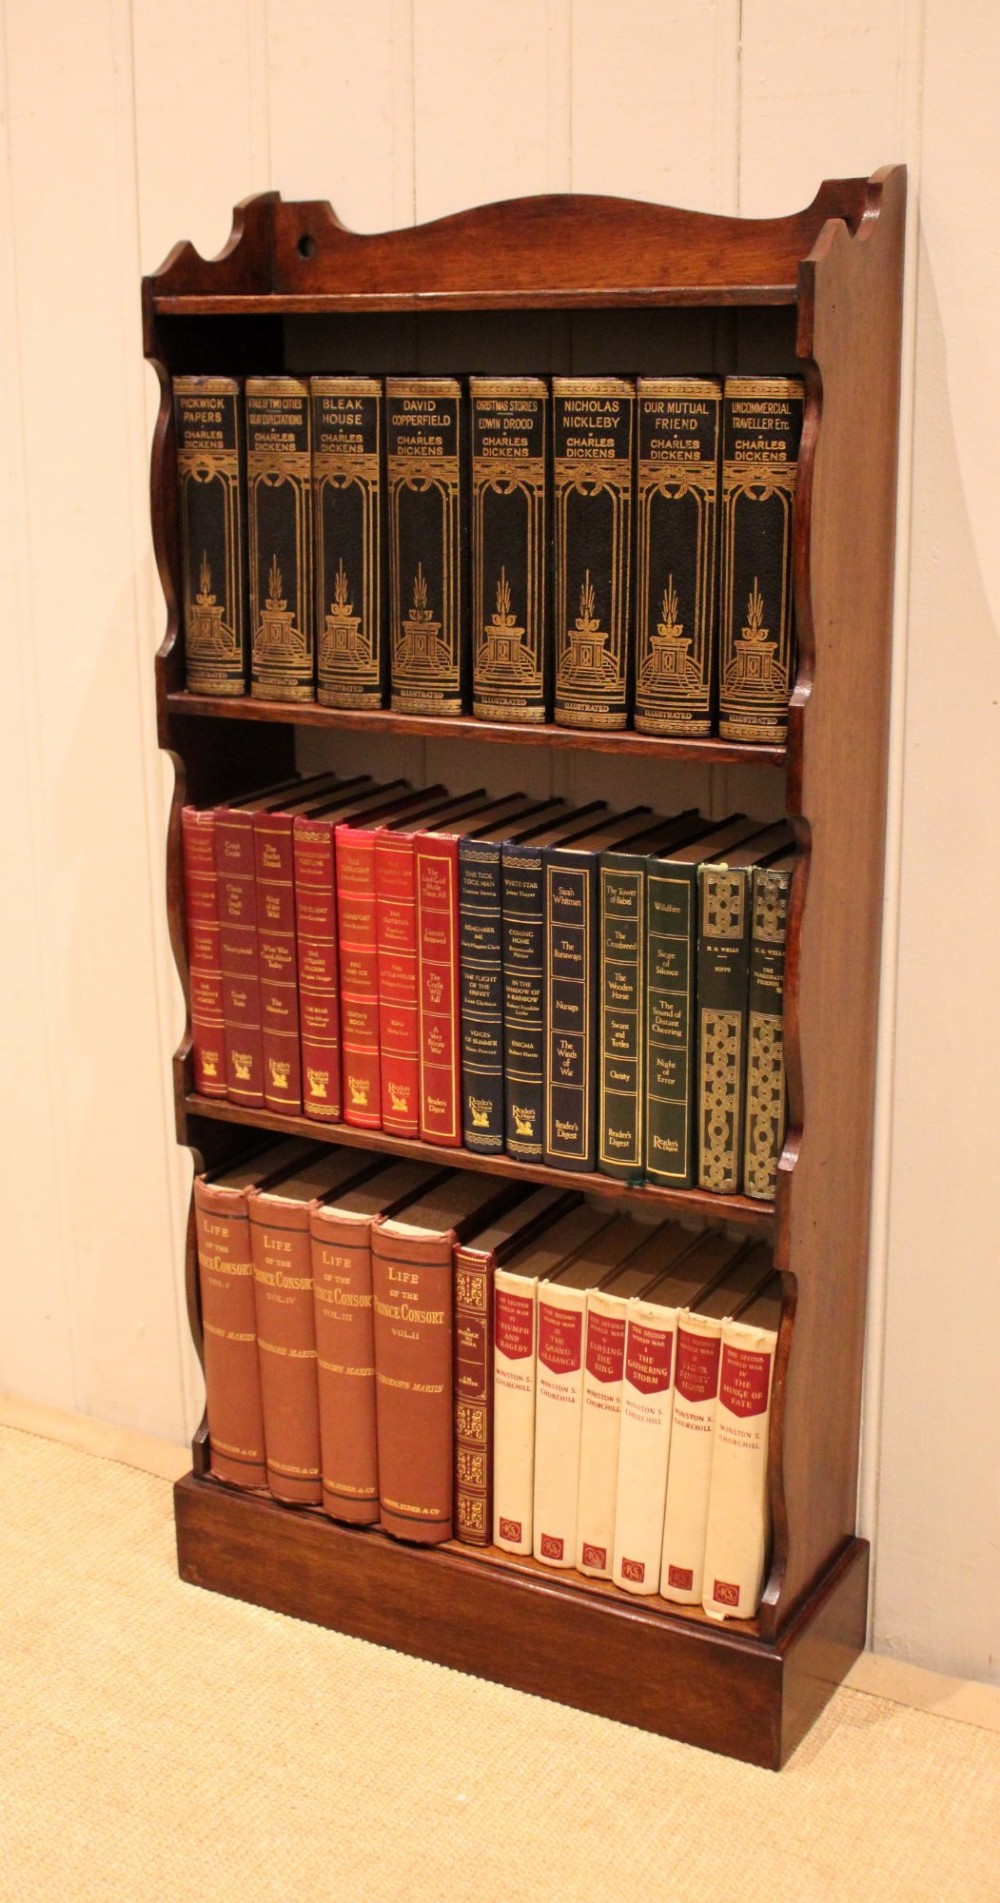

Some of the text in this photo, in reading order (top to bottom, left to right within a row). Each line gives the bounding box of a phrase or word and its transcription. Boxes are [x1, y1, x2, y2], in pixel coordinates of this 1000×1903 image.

[181, 398, 224, 408] PICKWICK
[323, 400, 363, 410] BLEAK
[404, 400, 436, 411] DAVID
[477, 401, 538, 412] CHRISTMAS STORIES
[565, 401, 619, 412] NICHOLAS
[645, 402, 709, 414] OUR MUTUAL
[732, 402, 791, 414] UNCOMMERCIAL
[184, 412, 221, 422] PAPERS
[323, 414, 362, 424] HOUSE
[392, 415, 450, 426] COPPERFIELD
[479, 419, 533, 429] EDWIN DROOD
[563, 417, 620, 428] NICKLEBY
[656, 419, 697, 430] FRIEND
[733, 418, 772, 430] TRAVELLER
[184, 431, 223, 439] CHARLES
[255, 433, 295, 441] CHARLES
[321, 434, 362, 442] CHARLES
[398, 436, 442, 445] CHARLES
[482, 438, 528, 446] CHARLES
[567, 438, 615, 447] CHARLES
[651, 440, 700, 449] CHARLES
[735, 441, 786, 450] CHARLES
[255, 443, 296, 451] DICKENS
[321, 444, 363, 452] DICKENS
[398, 446, 443, 455] DICKENS
[483, 448, 529, 457] DICKENS
[567, 449, 615, 458] DICKENS
[651, 451, 701, 460] DICKENS
[735, 452, 787, 461] DICKENS
[401, 691, 444, 699] ILLUSTRATED
[564, 702, 609, 713] ILLUSTRATED
[645, 710, 692, 720] ILLUSTRATED
[729, 715, 778, 725] ILLUSTRATED
[428, 868, 438, 876] The
[559, 887, 575, 896] Sarah
[553, 895, 581, 906] Whitman
[617, 897, 631, 905] Babel
[654, 902, 681, 913] Wildfire
[615, 931, 626, 939] The
[561, 941, 574, 950] The
[554, 948, 581, 961] Runaways
[658, 950, 676, 960] Siege
[656, 967, 679, 976] Silence
[615, 973, 626, 981] The
[506, 986, 529, 994] SHADOW
[608, 982, 633, 992] Wooden
[612, 991, 629, 1000] Horse
[660, 1001, 673, 1009] The
[653, 1008, 672, 1017] Sound
[611, 1021, 629, 1030] Swans
[655, 1016, 679, 1026] Distant
[615, 1031, 625, 1039] and
[652, 1025, 682, 1037] Cheering
[430, 1033, 442, 1041] Very
[560, 1040, 573, 1049] The
[611, 1039, 629, 1048] Turtles
[557, 1049, 577, 1058] Winds
[563, 1059, 570, 1067] of
[657, 1058, 676, 1068] Night
[610, 1071, 630, 1082] Christy
[657, 1075, 676, 1084] Error
[428, 1097, 447, 1107] Reader's
[429, 1104, 445, 1113] Digest
[556, 1120, 578, 1130] Reader's
[557, 1129, 577, 1140] Digest
[608, 1128, 631, 1138] Reader's
[609, 1138, 629, 1147] Digest
[654, 1135, 678, 1147] Reader's
[203, 1220, 228, 1237] LIFE
[264, 1236, 291, 1251] LIFE
[322, 1252, 350, 1268] LIFE
[214, 1256, 252, 1275] CONSORT
[335, 1276, 350, 1284] THE
[388, 1267, 419, 1284] LIFE
[402, 1292, 418, 1300] THE
[401, 1304, 444, 1324] CONSORT
[633, 1335, 649, 1344] WORLD
[644, 1329, 666, 1340] SECOND
[550, 1336, 564, 1344] THE
[546, 1344, 570, 1354] GRAND
[590, 1343, 622, 1356] CLOSING
[598, 1355, 611, 1364] THE
[639, 1355, 654, 1363] THE
[741, 1353, 763, 1363] SECOND
[594, 1363, 613, 1374] RING
[628, 1360, 667, 1376] GATHERING
[728, 1359, 746, 1368] WORLD
[496, 1368, 523, 1380] WINSTON
[633, 1372, 658, 1384] STORM
[413, 1384, 442, 1393] MARTIN
[496, 1378, 531, 1391] CHURCHILL
[541, 1380, 568, 1392] WINSTON
[682, 1381, 705, 1392] HOUR
[735, 1379, 751, 1389] THE
[540, 1389, 575, 1403] CHURCHILL
[587, 1389, 614, 1401] WINSTON
[724, 1385, 748, 1398] HINGE
[587, 1399, 620, 1412] CHURCHILL
[626, 1400, 655, 1415] WINSTON
[731, 1399, 752, 1408] FATE
[626, 1409, 661, 1425] CHURCHILL
[675, 1409, 704, 1422] WINSTON
[674, 1418, 712, 1432] CHURCHILL
[720, 1425, 750, 1438] WINSTON
[720, 1435, 760, 1449] CHURCHILL
